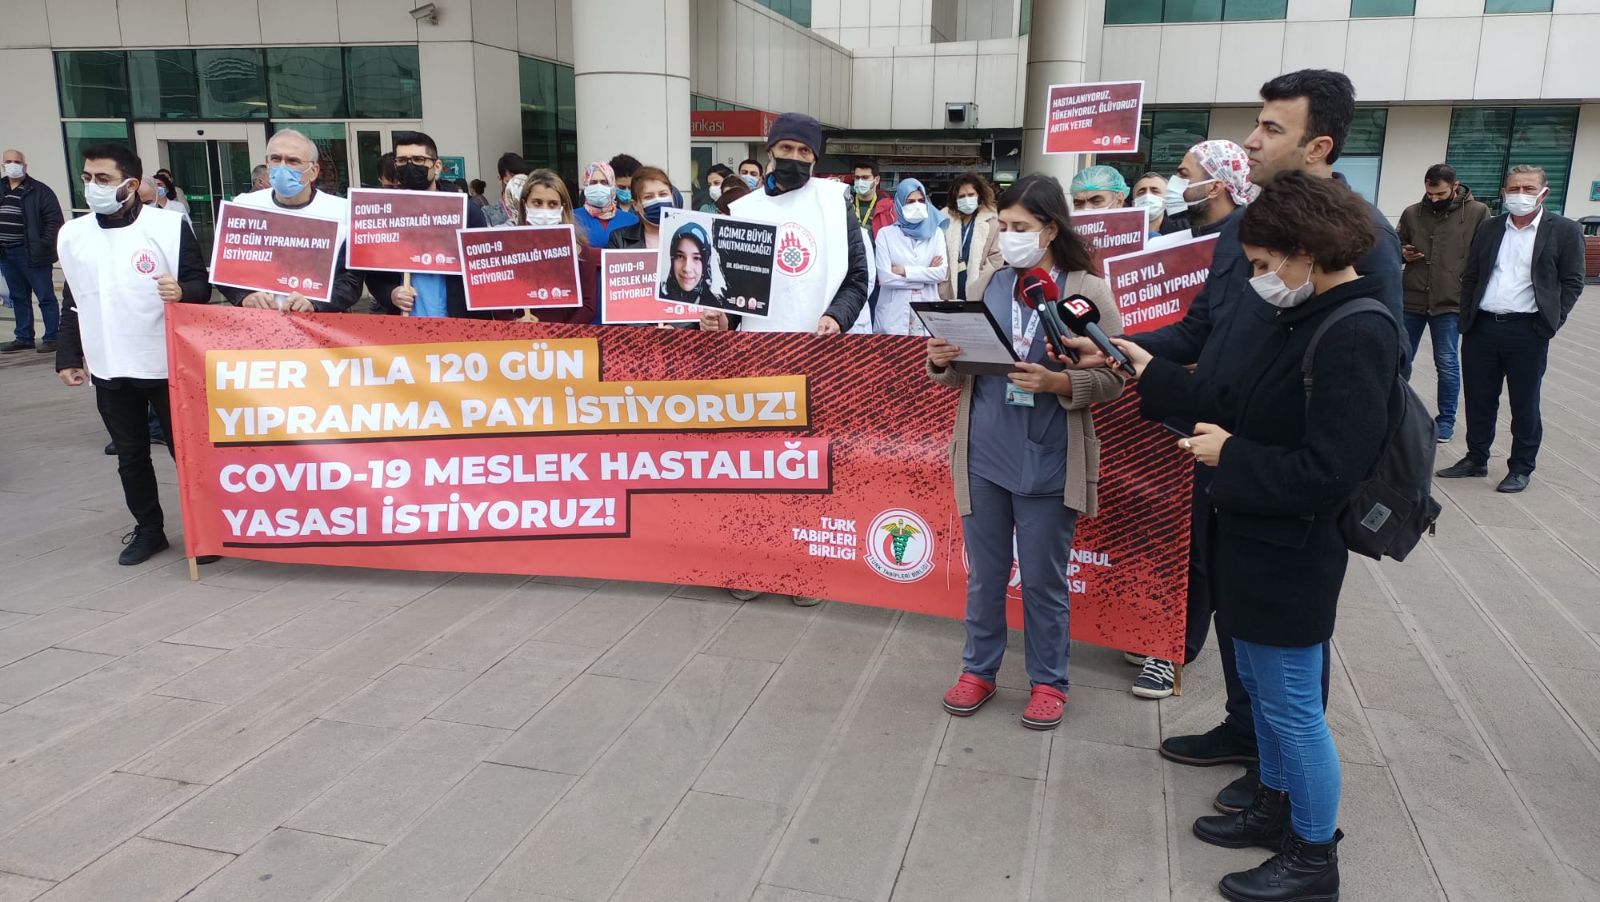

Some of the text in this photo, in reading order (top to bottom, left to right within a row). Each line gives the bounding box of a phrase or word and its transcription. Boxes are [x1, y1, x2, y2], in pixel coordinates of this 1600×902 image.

[691, 118, 725, 132] ankası
[1050, 118, 1093, 133] ARTIK YETER!
[354, 203, 392, 216] COVID-19
[227, 217, 268, 231] HER YILA
[354, 213, 461, 230] MESLEK HASTALIĞI YASASI
[1075, 221, 1107, 236] YORUZ,
[225, 232, 330, 250] 120 GÜN YIPRANMA PAYI
[354, 232, 400, 245] İSTİYORUZ!
[718, 226, 773, 244] ACIMIZ BÜYÜK
[1093, 231, 1141, 249] ÖLÜYORUZ!
[223, 246, 273, 262] İSTİYORUZ!
[466, 240, 503, 256] COVID-19
[468, 256, 501, 271] MESLEK
[502, 248, 542, 266] HASTALIĞI
[543, 246, 571, 259] YASASI
[609, 260, 645, 274] COVID-19
[470, 269, 514, 286] İSTİYORUZ!
[609, 272, 657, 287] MESLEK HAS
[1117, 262, 1165, 288] HER YILA
[609, 286, 653, 301] İSTİYORUZ!
[1119, 268, 1210, 308] 120 GÜN YIPRAN
[1121, 298, 1180, 328] İSTİYORUZ!
[215, 342, 584, 390] HER YILA 120 GÜN
[215, 386, 798, 436] YIPRANMA PAYI İSTİYORUZ!
[219, 441, 819, 493] COVID-19 MESLEK HASTALIĞI
[222, 492, 616, 537] YASASI İSTİYORUZ!
[1069, 548, 1113, 567] NBUL
